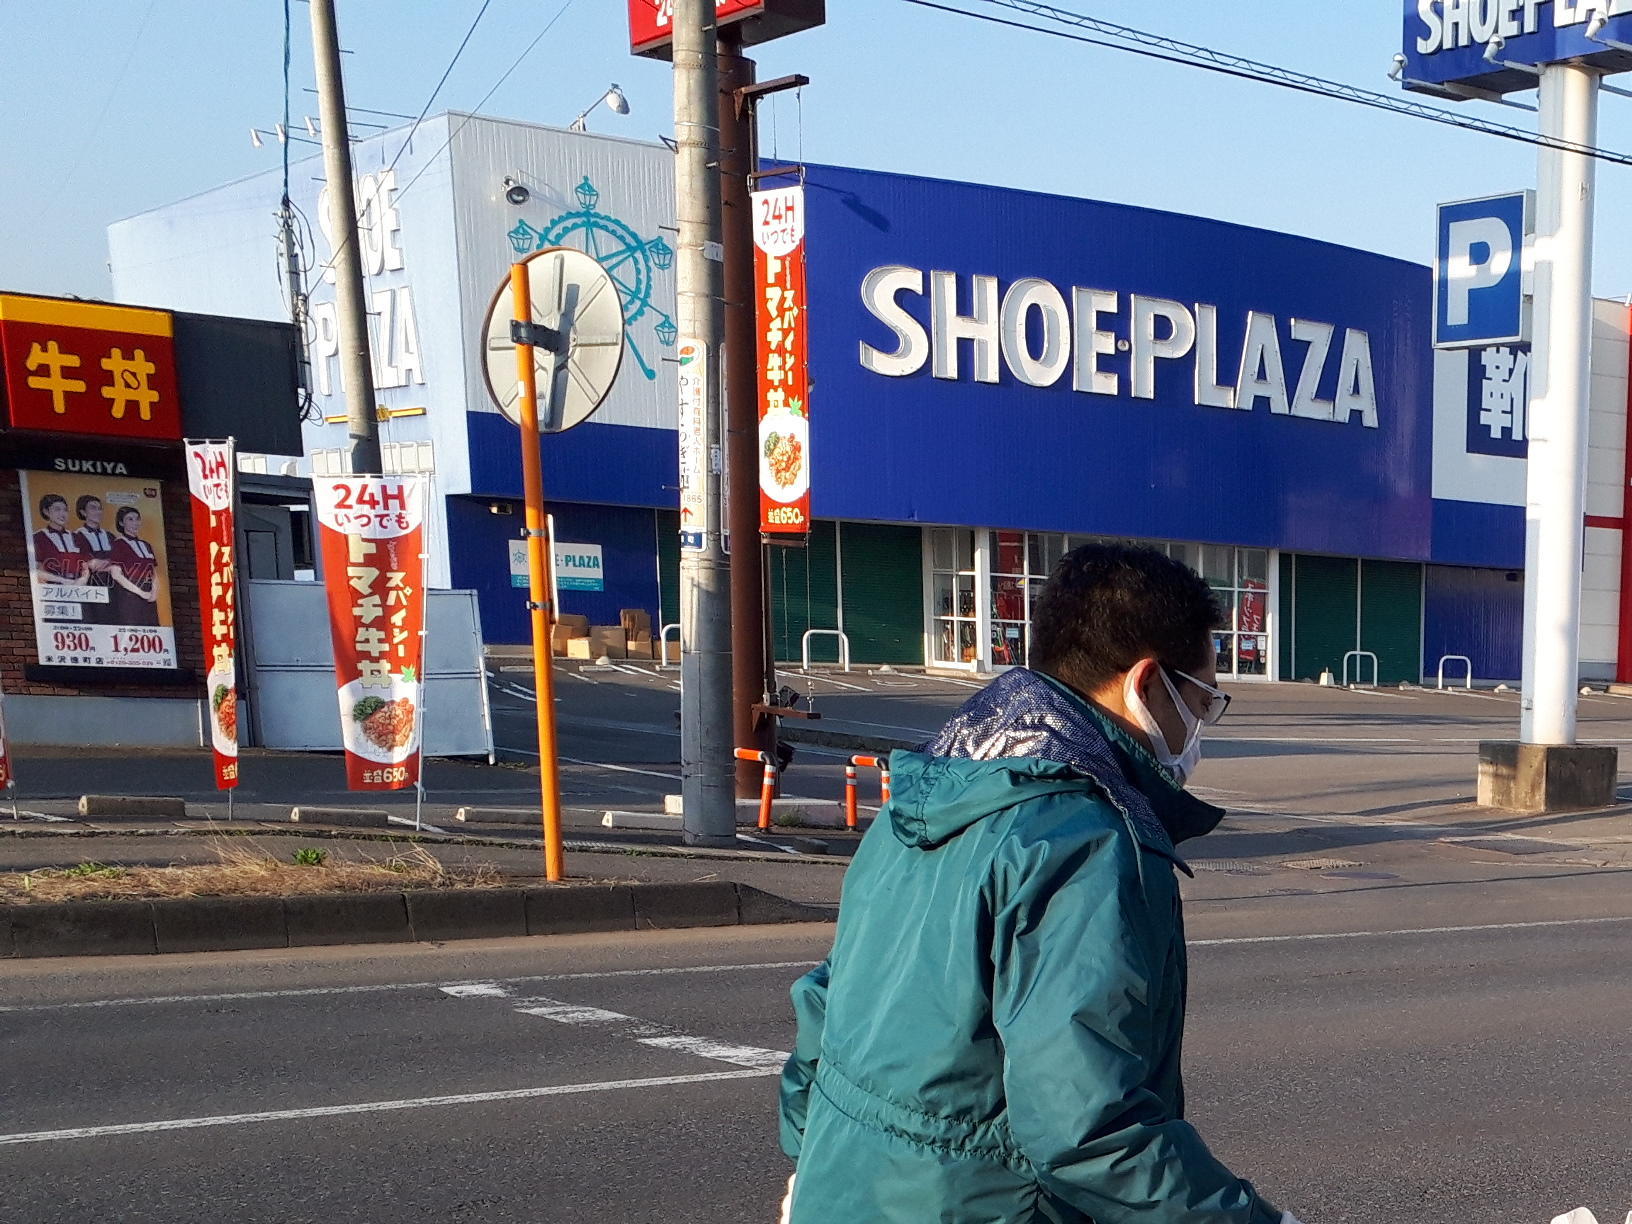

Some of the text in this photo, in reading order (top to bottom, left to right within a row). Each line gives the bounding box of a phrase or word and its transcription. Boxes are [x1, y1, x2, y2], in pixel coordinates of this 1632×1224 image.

[762, 196, 796, 227] 24H
[762, 227, 796, 245] いつでも
[1447, 217, 1513, 326] P
[26, 340, 160, 420] 牛丼
[54, 457, 128, 476] SUKIYA
[332, 483, 407, 511] 24H
[334, 512, 410, 530] いつでも
[42, 587, 105, 600] アルバイト
[386, 571, 413, 657] スパイシー
